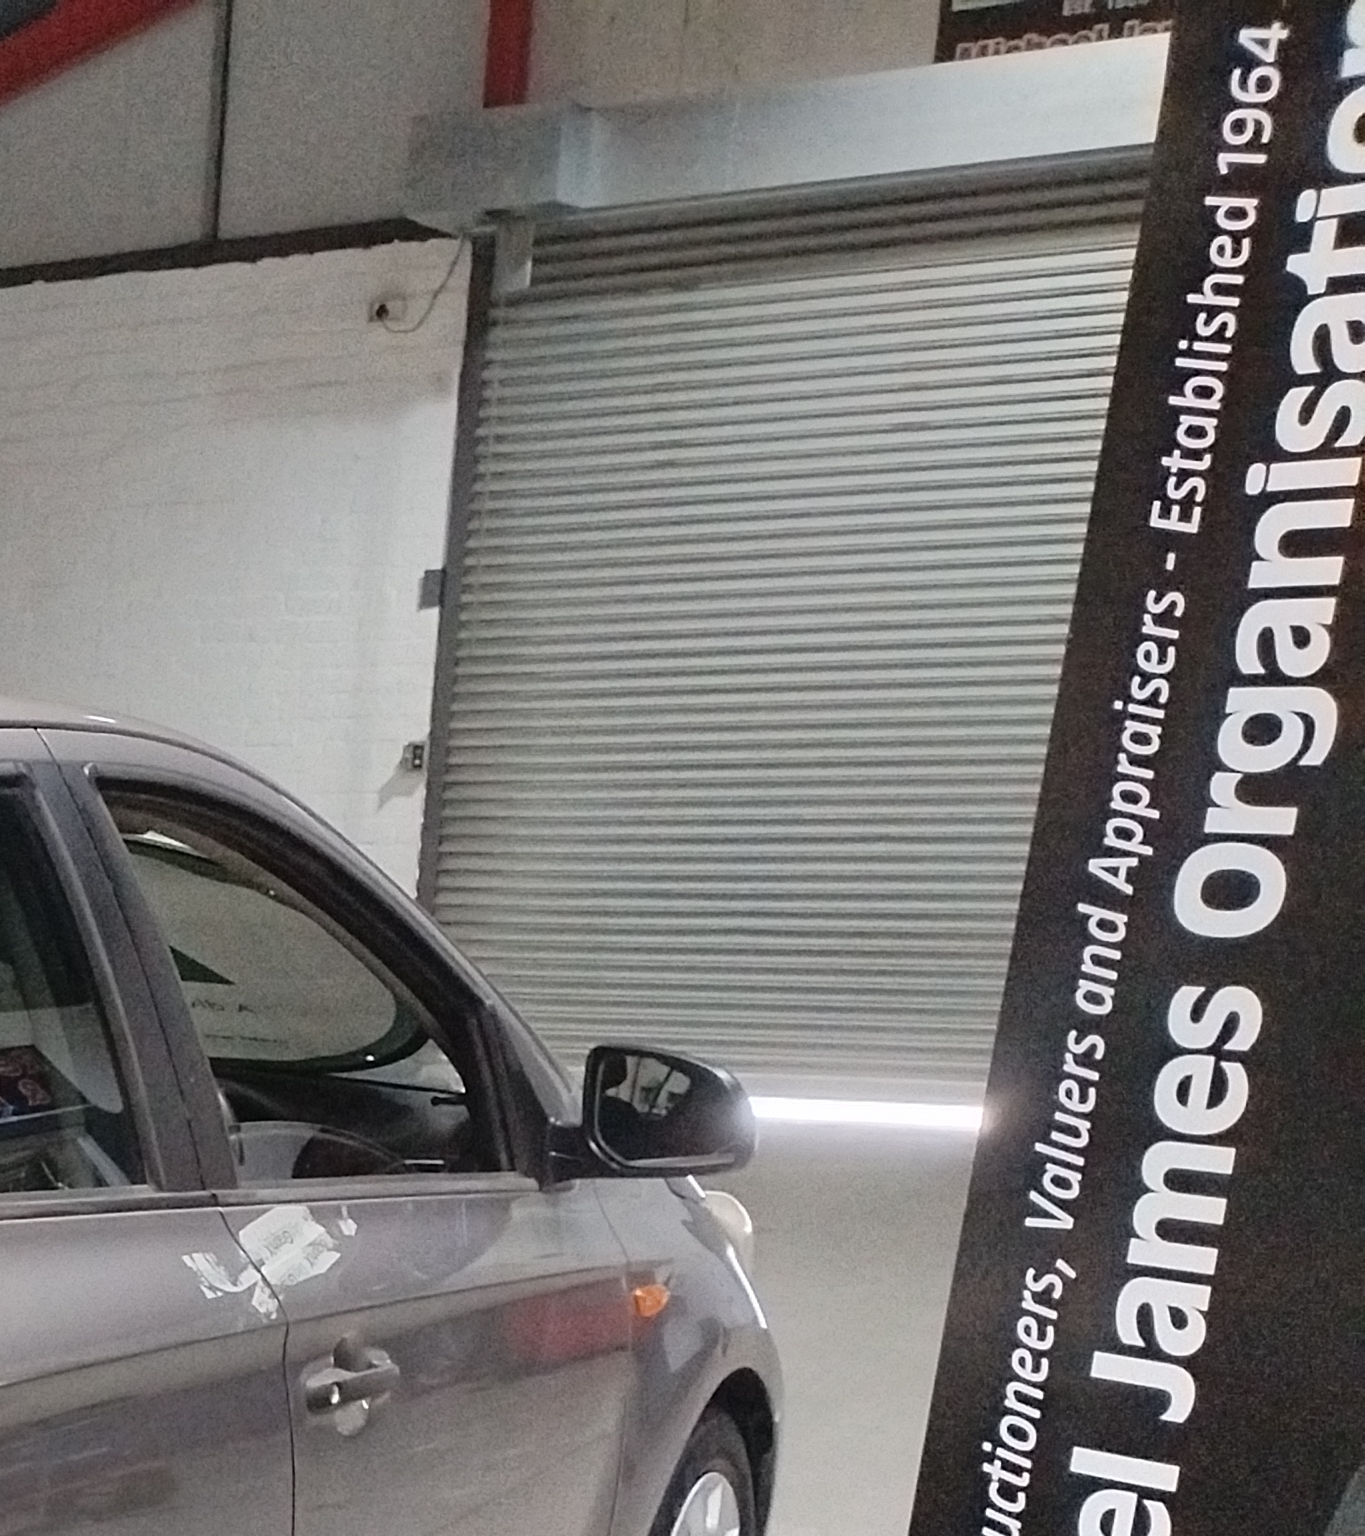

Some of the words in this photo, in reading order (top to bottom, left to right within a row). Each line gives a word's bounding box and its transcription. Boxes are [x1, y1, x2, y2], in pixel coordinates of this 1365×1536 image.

[1217, 20, 1290, 175] 1964
[1150, 196, 1260, 533] Established
[1174, 0, 1365, 938] Organisati
[1088, 589, 1184, 896] Appraisers
[1075, 904, 1128, 1015] and
[1025, 1030, 1104, 1230] Valuers
[1090, 985, 1263, 1424] James
